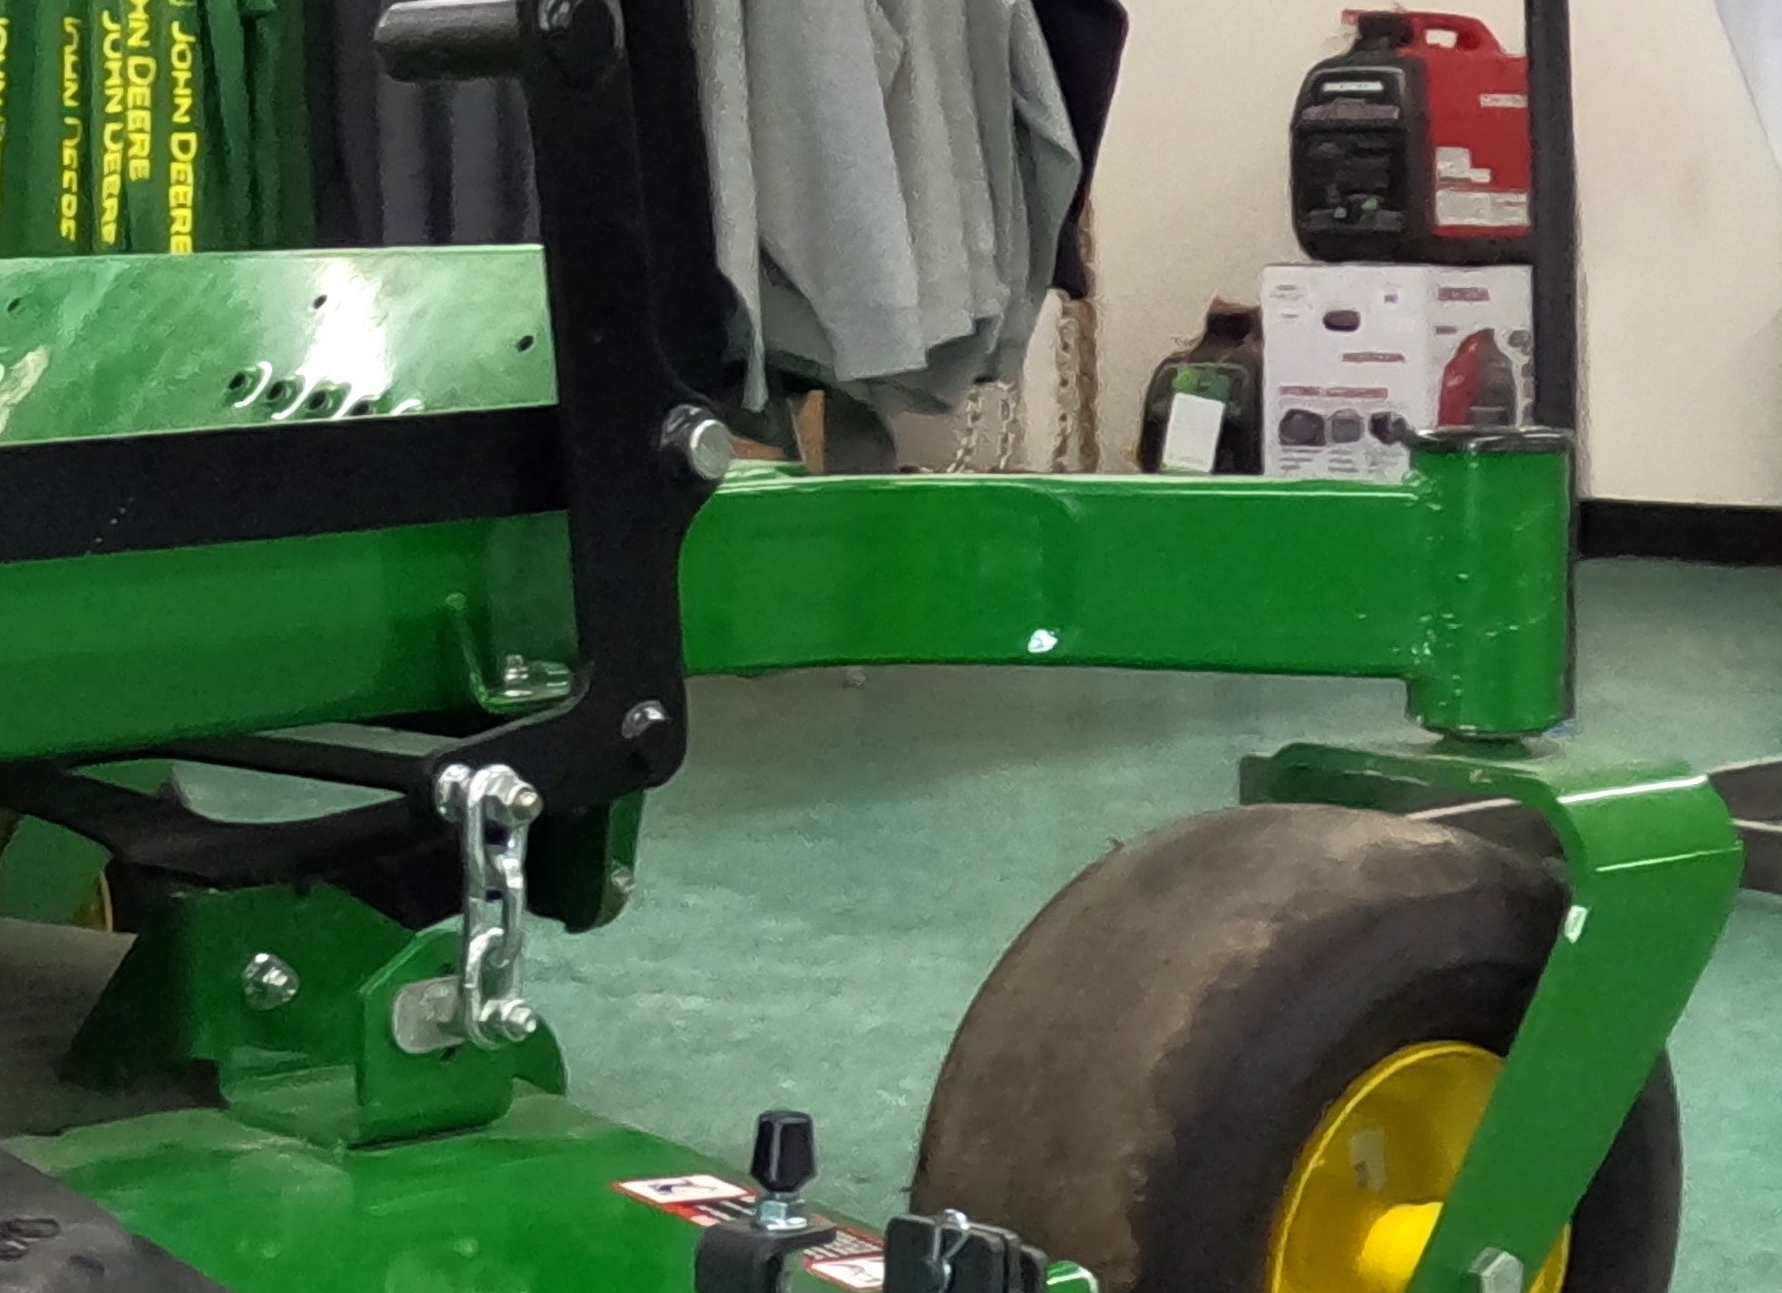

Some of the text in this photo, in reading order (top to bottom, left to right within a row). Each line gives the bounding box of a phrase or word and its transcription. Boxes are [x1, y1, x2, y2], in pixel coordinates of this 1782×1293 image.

[127, 56, 157, 182] DEERE
[170, 21, 197, 255] JOHN DEERE
